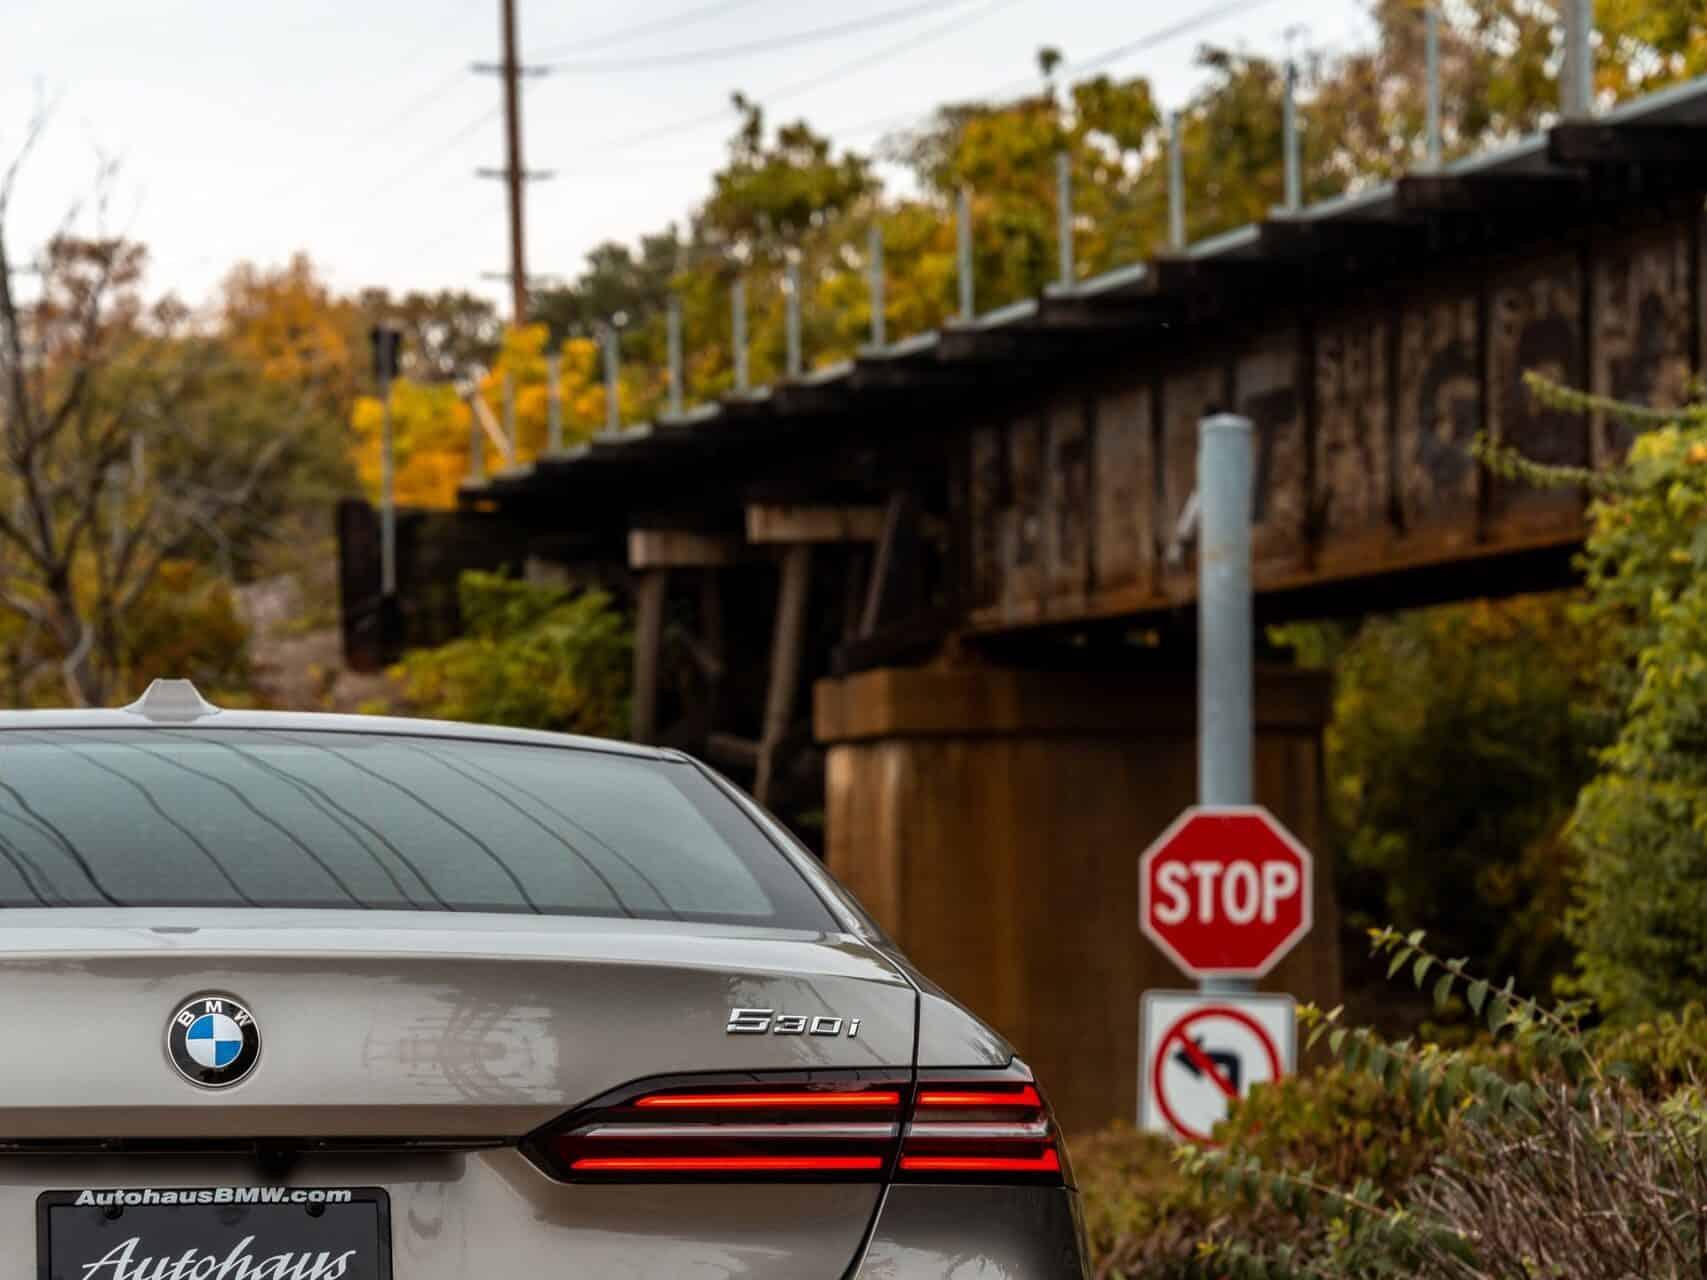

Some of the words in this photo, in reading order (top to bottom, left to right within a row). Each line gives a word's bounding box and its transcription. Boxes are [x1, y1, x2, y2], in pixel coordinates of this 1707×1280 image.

[1153, 859, 1298, 925] STOP
[178, 1001, 252, 1027] BMW
[727, 1008, 860, 1037] 530i
[75, 1187, 351, 1205] AutohausBMW.com
